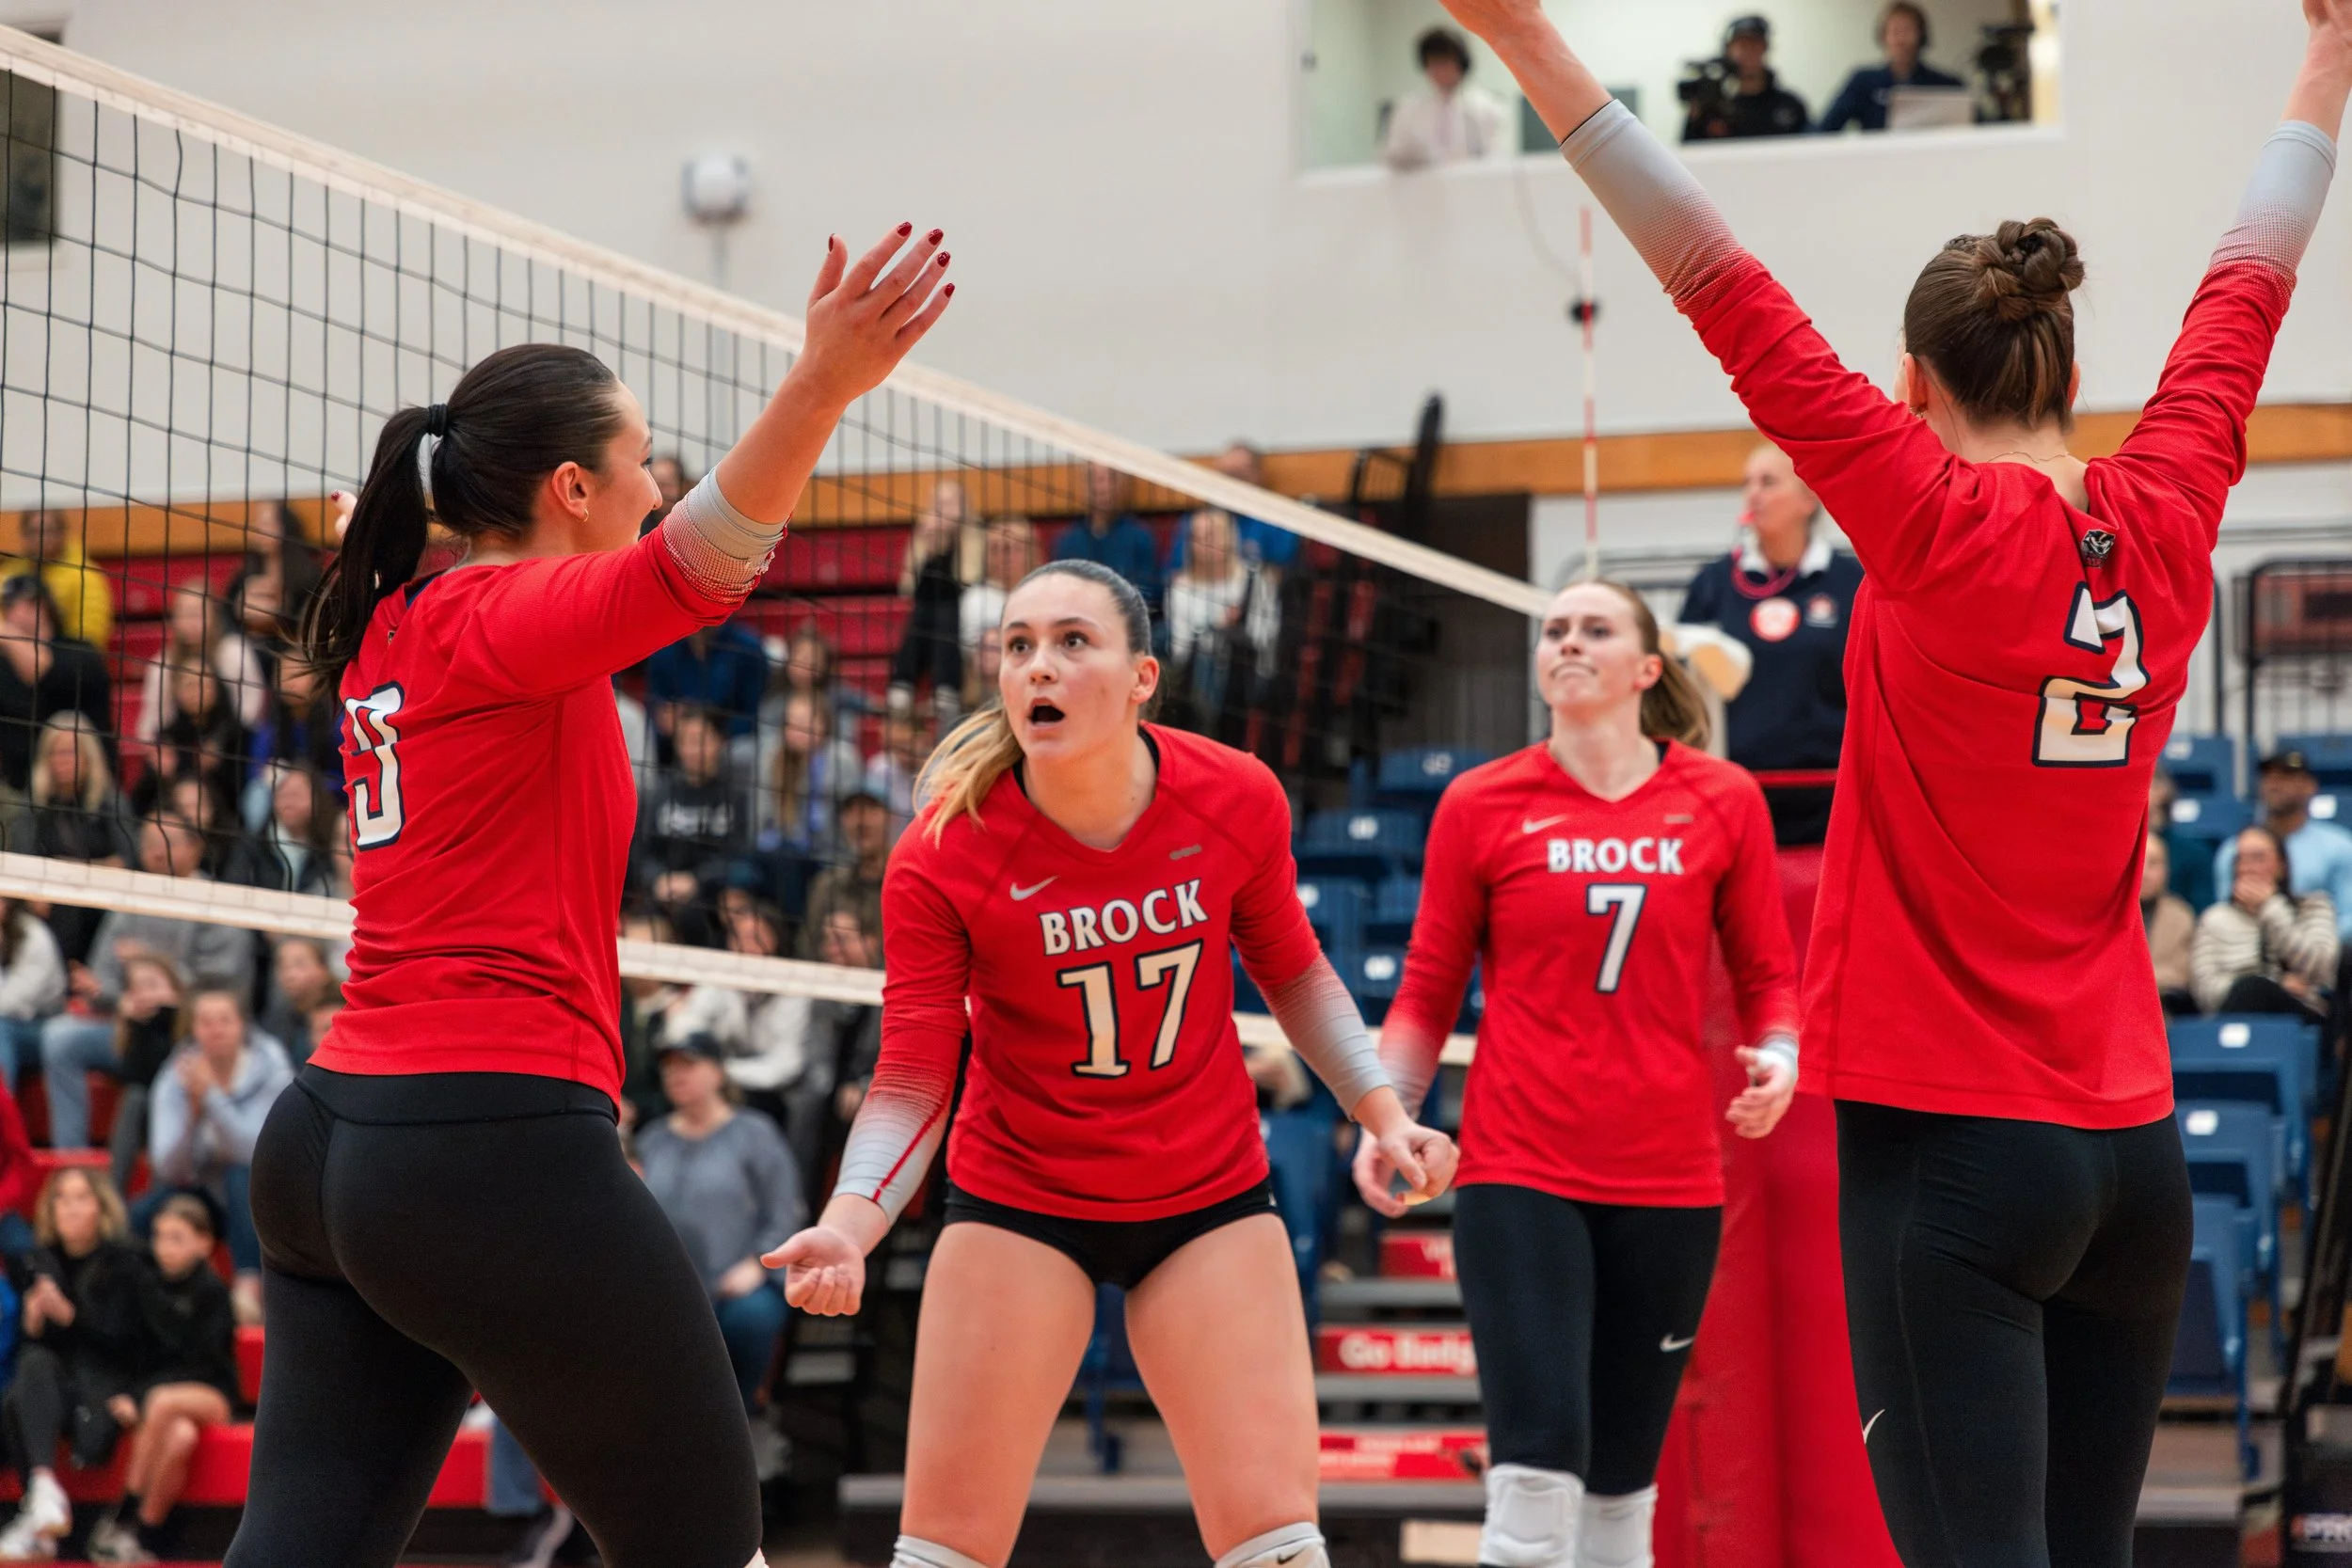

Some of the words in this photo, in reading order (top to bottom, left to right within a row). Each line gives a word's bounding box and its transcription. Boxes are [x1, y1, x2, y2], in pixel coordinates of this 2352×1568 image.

[2032, 580, 2151, 768] 2
[1547, 837, 1683, 875] BROCK
[1039, 879, 1209, 956] BROCK
[1586, 882, 1647, 994] 7
[1057, 938, 1203, 1080] 17
